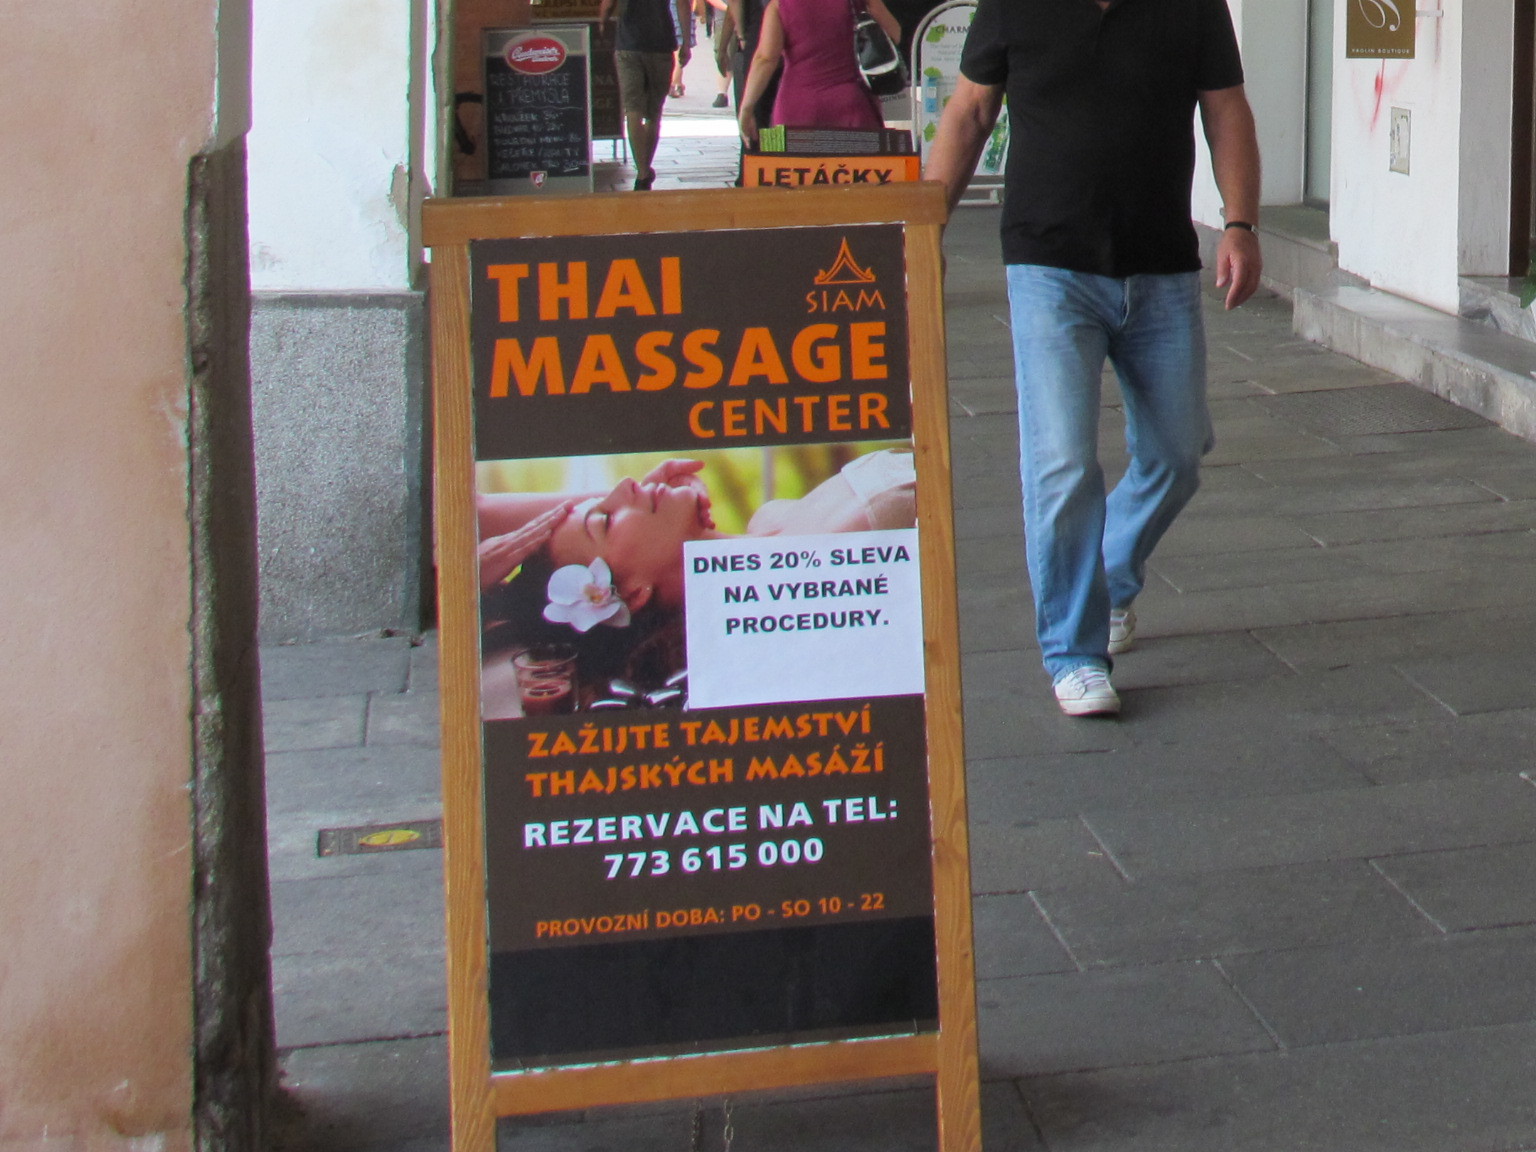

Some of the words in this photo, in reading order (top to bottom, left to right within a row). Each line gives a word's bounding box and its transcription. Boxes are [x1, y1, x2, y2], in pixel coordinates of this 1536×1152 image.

[757, 165, 894, 187] LETÁČKY
[486, 256, 683, 323] THAI
[805, 289, 886, 314] SIAM
[489, 321, 889, 399] MASSAGE
[687, 392, 891, 439] CENTER
[693, 554, 762, 575] DNES
[769, 550, 822, 571] 20%
[830, 545, 911, 567] SLEVA
[724, 585, 760, 605] NA
[767, 575, 890, 603] VYBRANÉ
[725, 608, 890, 636] PROCEDURY.
[528, 723, 670, 758] ZAŽIJTE
[680, 703, 872, 746] TAJEMSTVÍ
[526, 755, 734, 798] THAJSKÝCH
[746, 742, 885, 782] MASÁŽÍ
[523, 806, 748, 848] REZERVACE
[758, 801, 813, 831] NA
[823, 795, 899, 825] TEL:
[604, 849, 670, 880] 773
[681, 844, 748, 874] 615
[758, 837, 825, 867] 000
[536, 909, 649, 939] PROVOZNÍ
[655, 906, 726, 931] DOBA:
[732, 903, 761, 922] PO
[781, 899, 811, 918] SO
[818, 896, 841, 915] 10
[861, 893, 885, 912] 22
